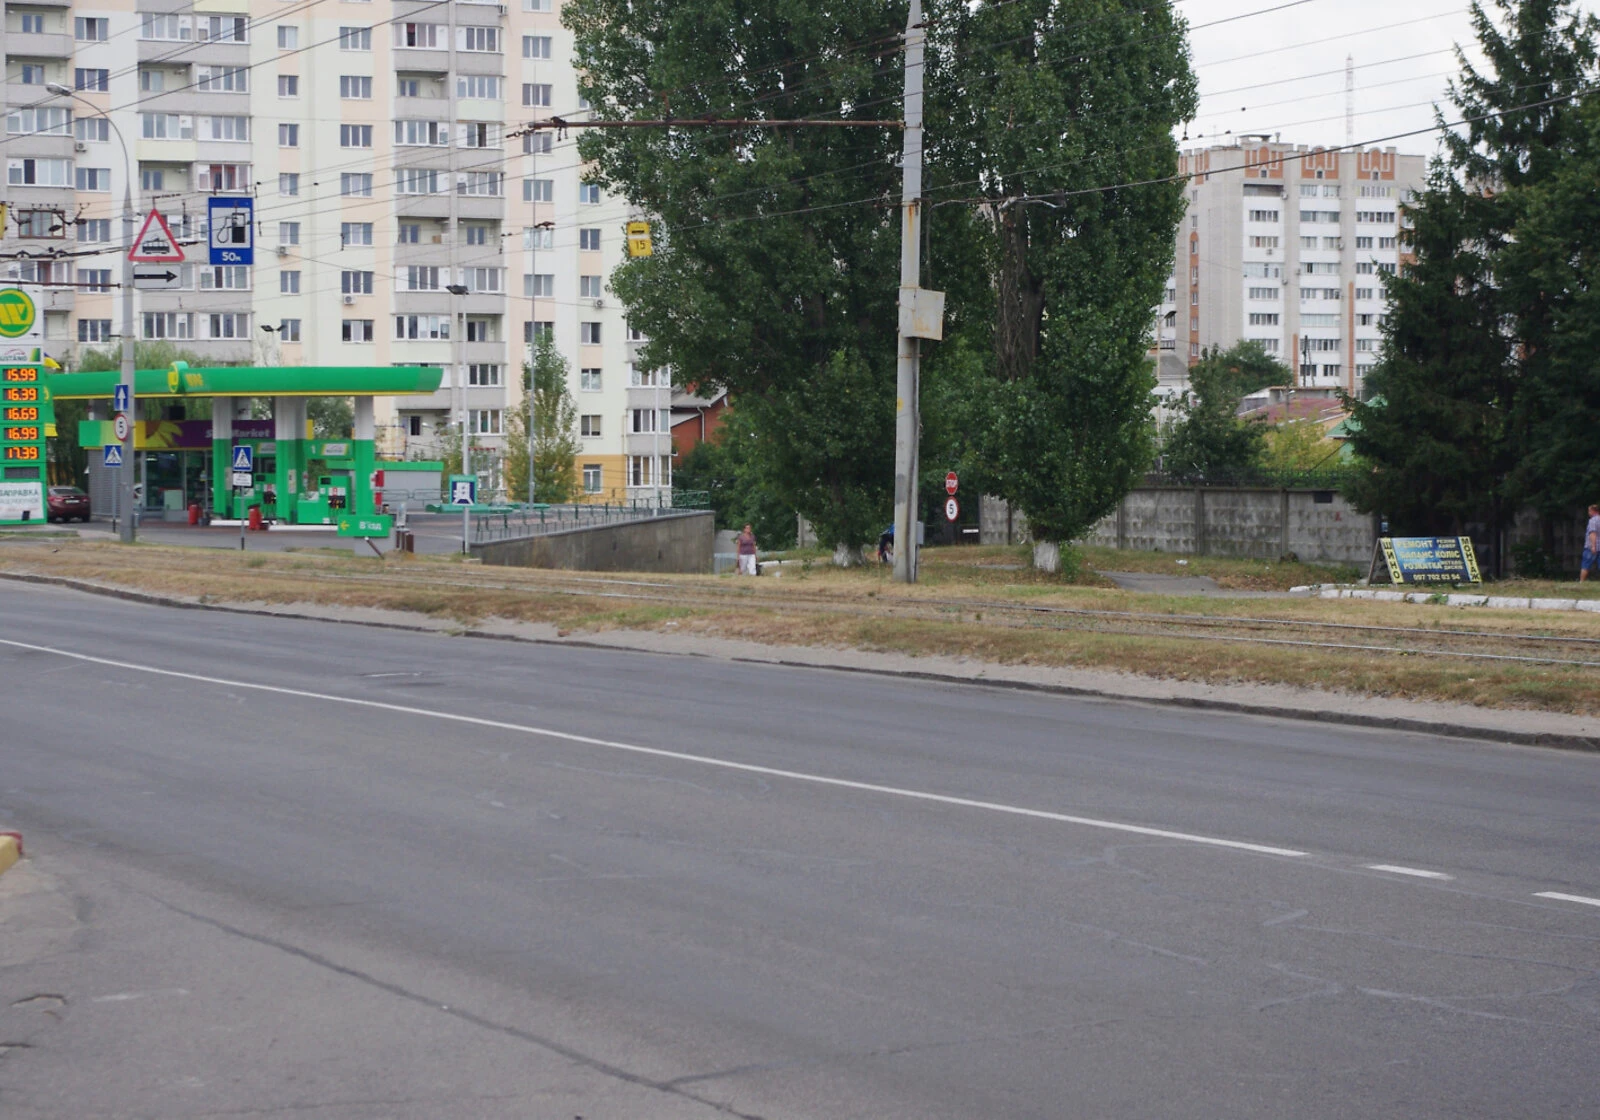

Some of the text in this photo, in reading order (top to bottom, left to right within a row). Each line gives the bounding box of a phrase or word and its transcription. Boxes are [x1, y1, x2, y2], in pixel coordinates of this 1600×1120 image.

[635, 239, 646, 250] 15
[7, 368, 36, 381] 15.99
[7, 388, 37, 400] 16.39
[8, 407, 37, 420] 16.69
[8, 427, 38, 439] 16.99
[9, 447, 38, 459] 17.39
[949, 503, 955, 515] 5
[1397, 540, 1433, 548] РЕМОНТ
[1461, 537, 1480, 580] МОНТАЖ
